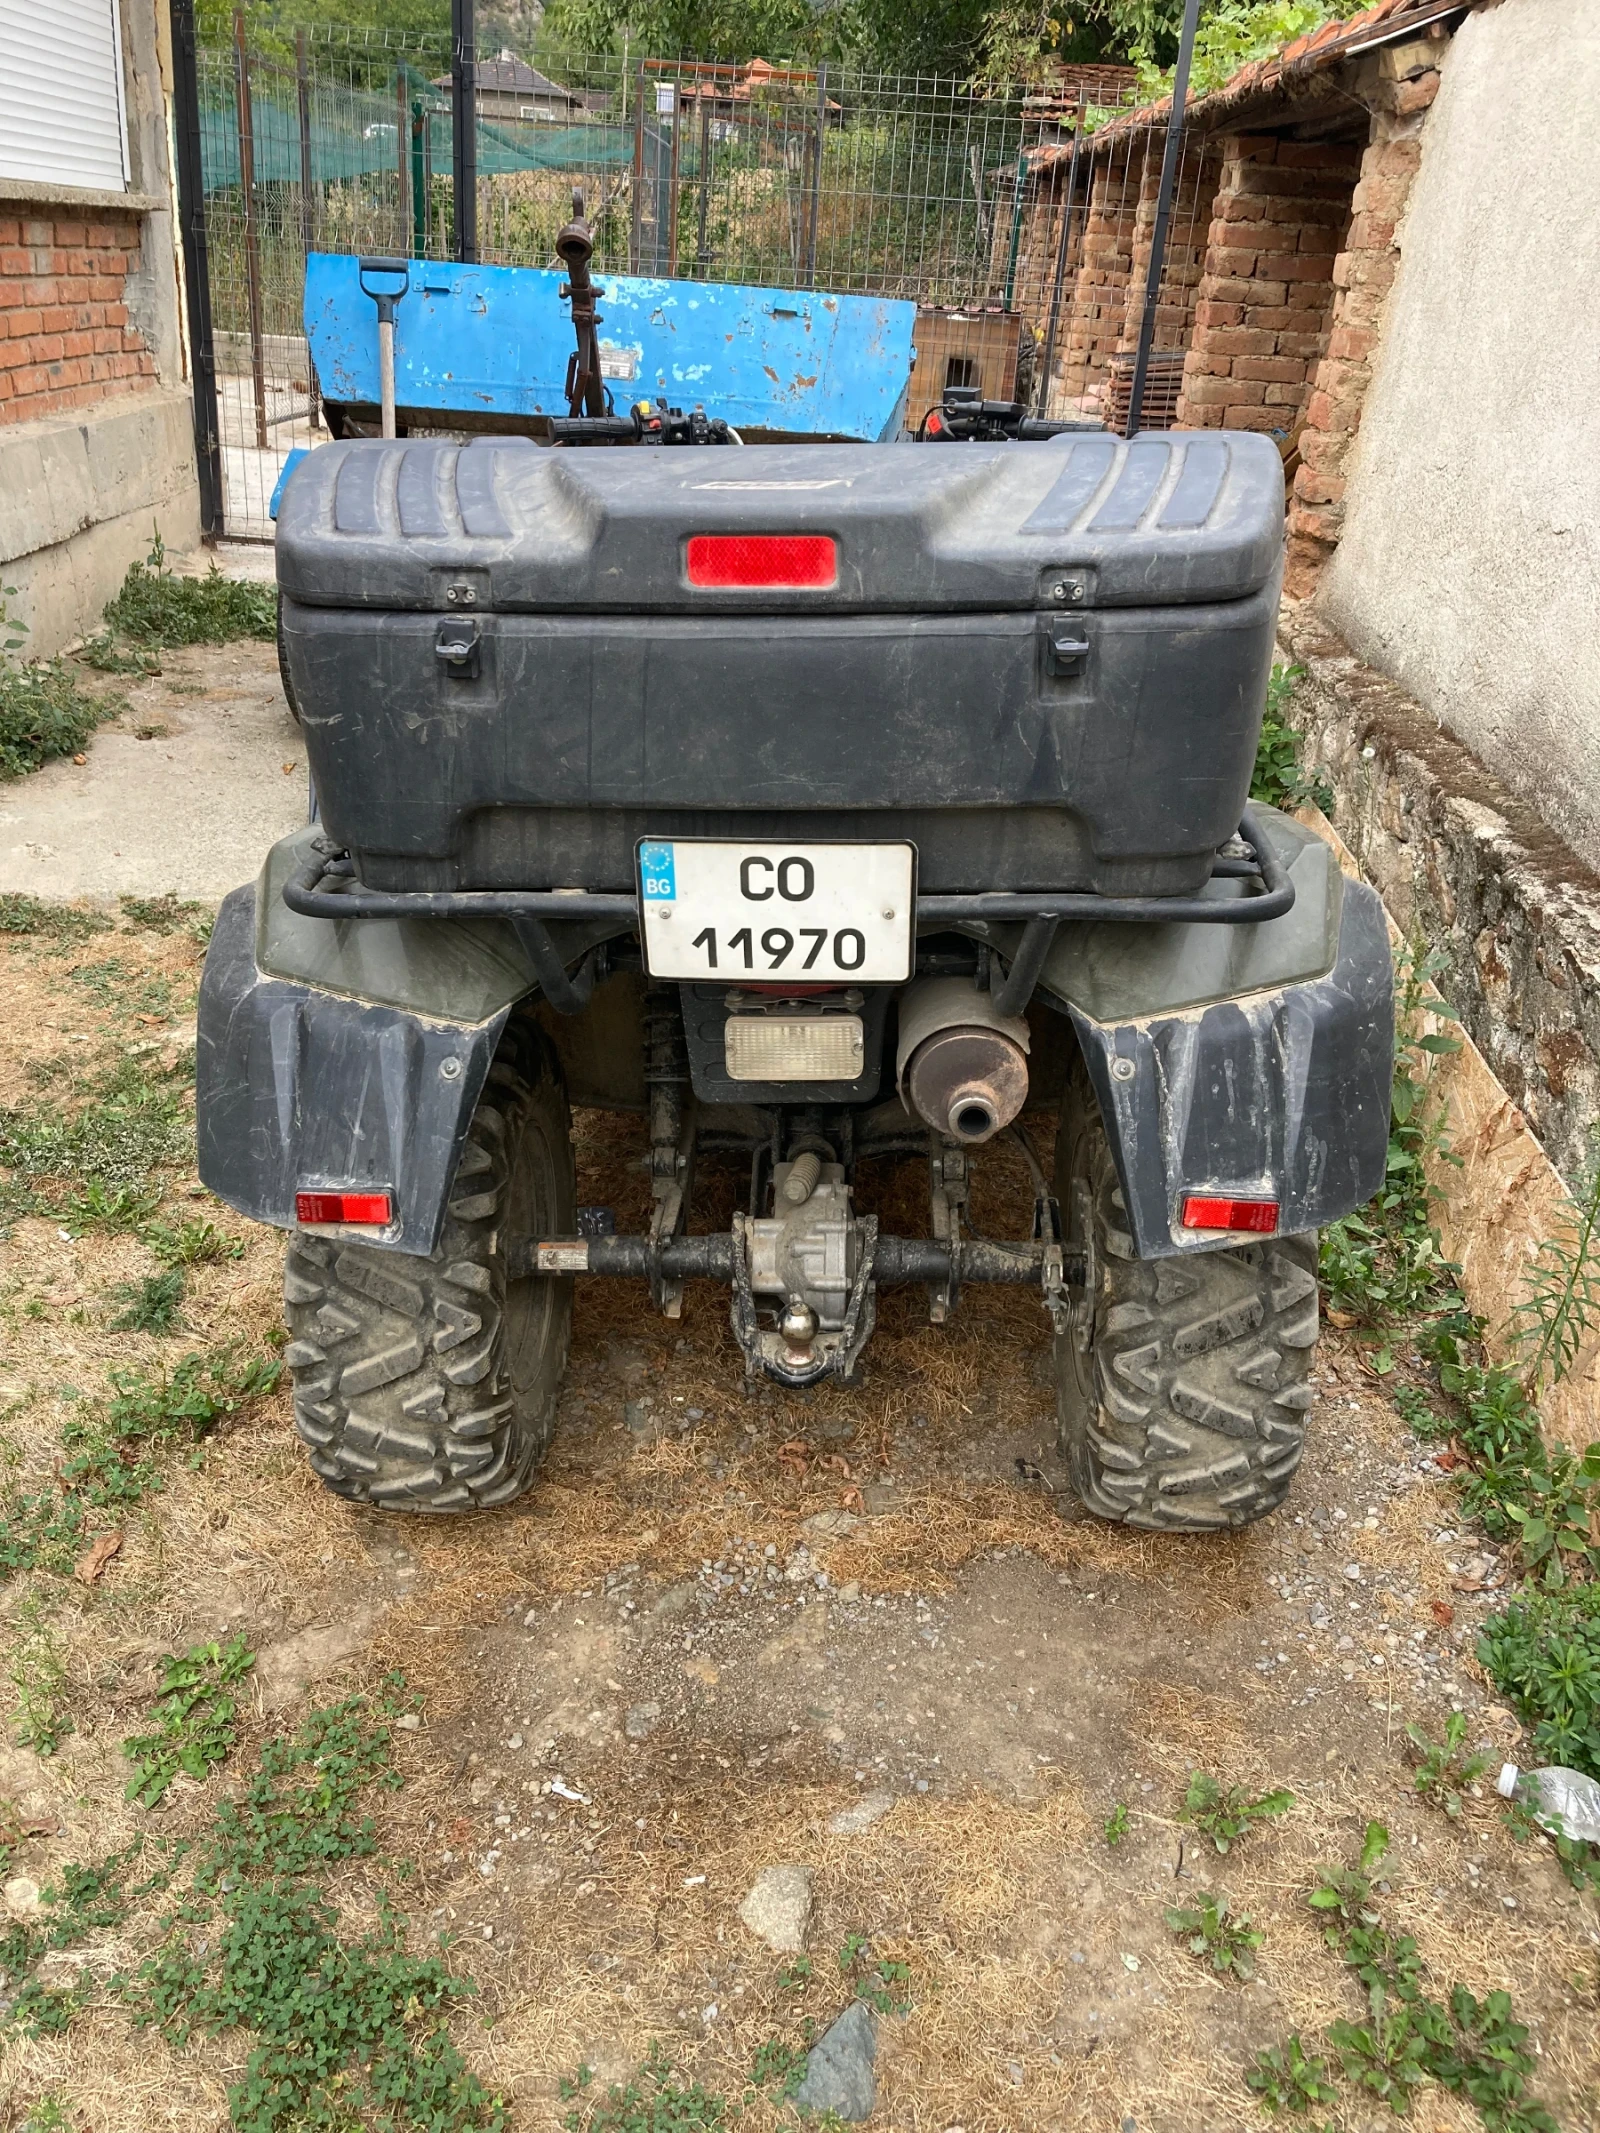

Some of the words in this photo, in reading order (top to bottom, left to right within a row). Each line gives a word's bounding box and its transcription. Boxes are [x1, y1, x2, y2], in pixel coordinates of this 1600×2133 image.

[646, 878, 671, 894] BG
[739, 856, 815, 901] CO
[691, 927, 866, 971] 11970
